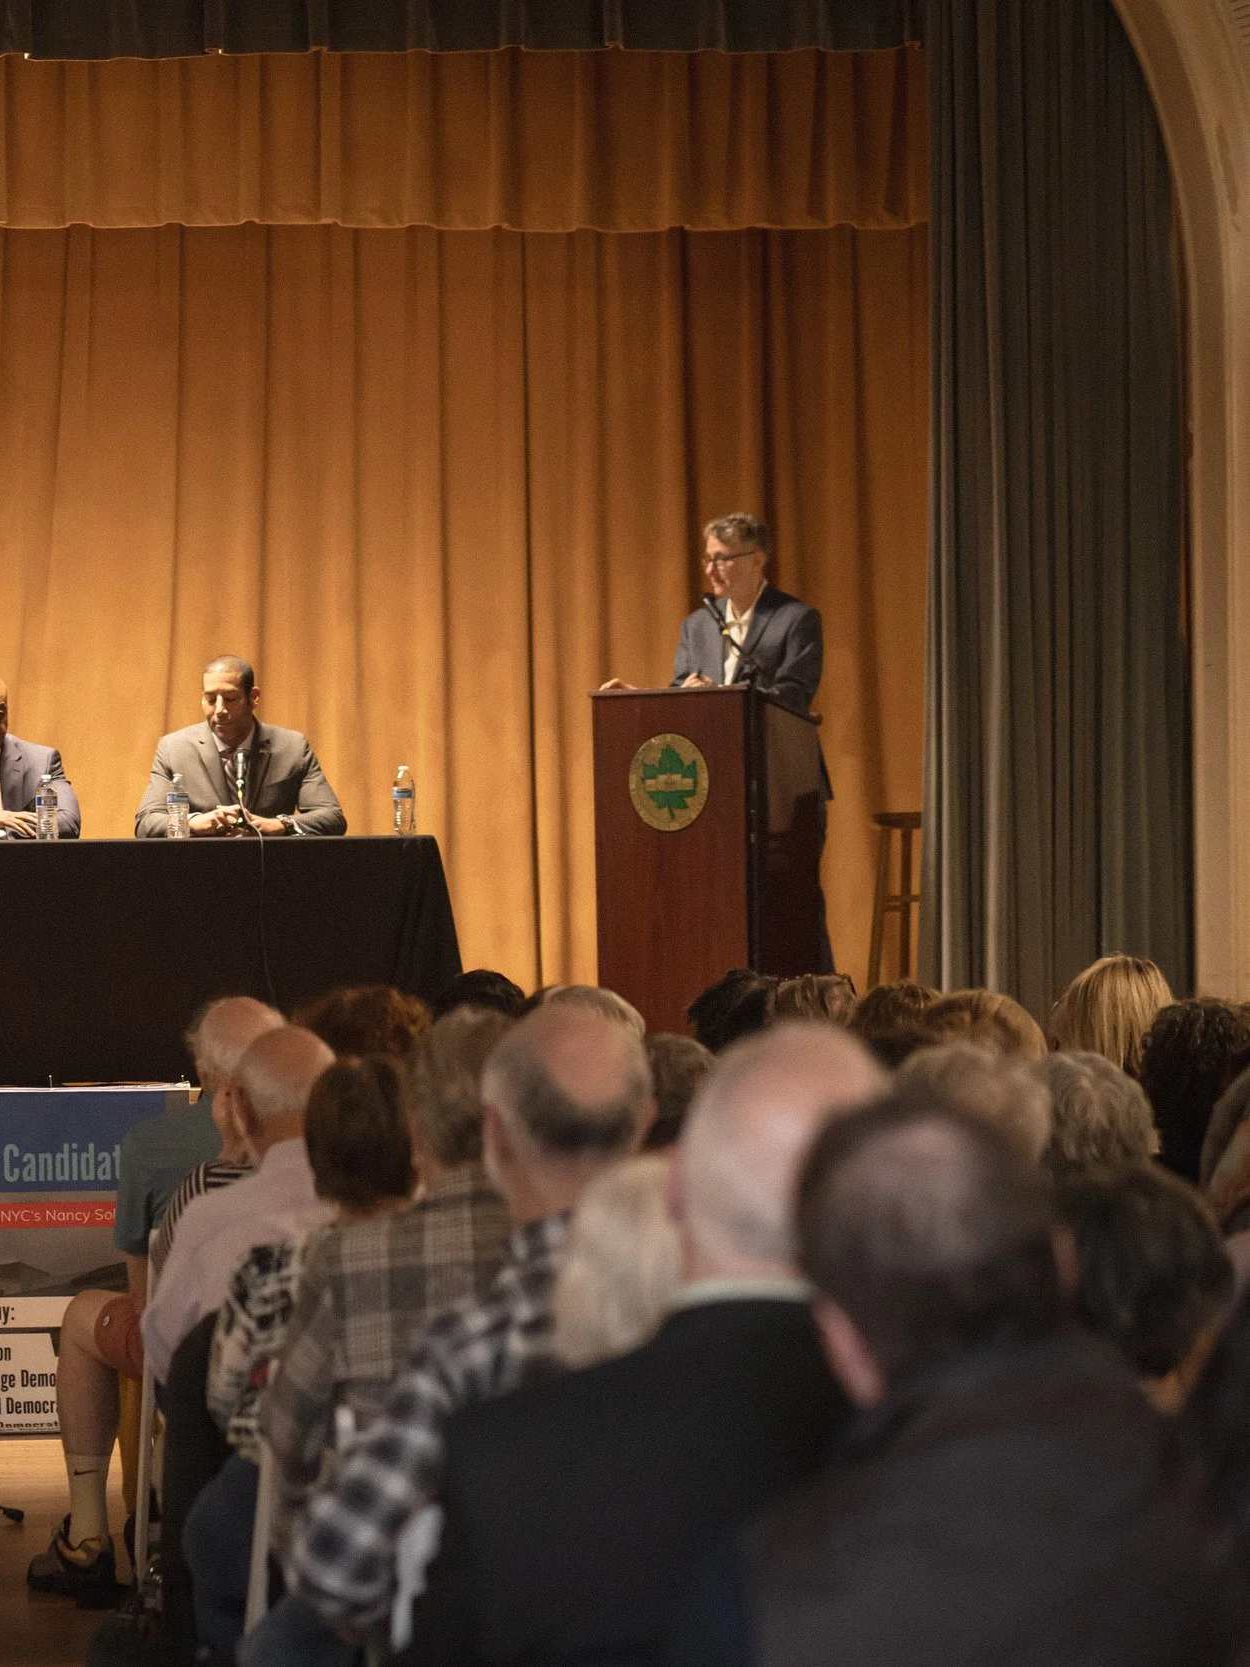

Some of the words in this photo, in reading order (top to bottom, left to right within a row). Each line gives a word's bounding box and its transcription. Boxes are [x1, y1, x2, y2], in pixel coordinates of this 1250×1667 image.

[3, 1143, 121, 1183] Candidat
[45, 1209, 91, 1224] Nancy
[21, 1369, 57, 1388] Demo
